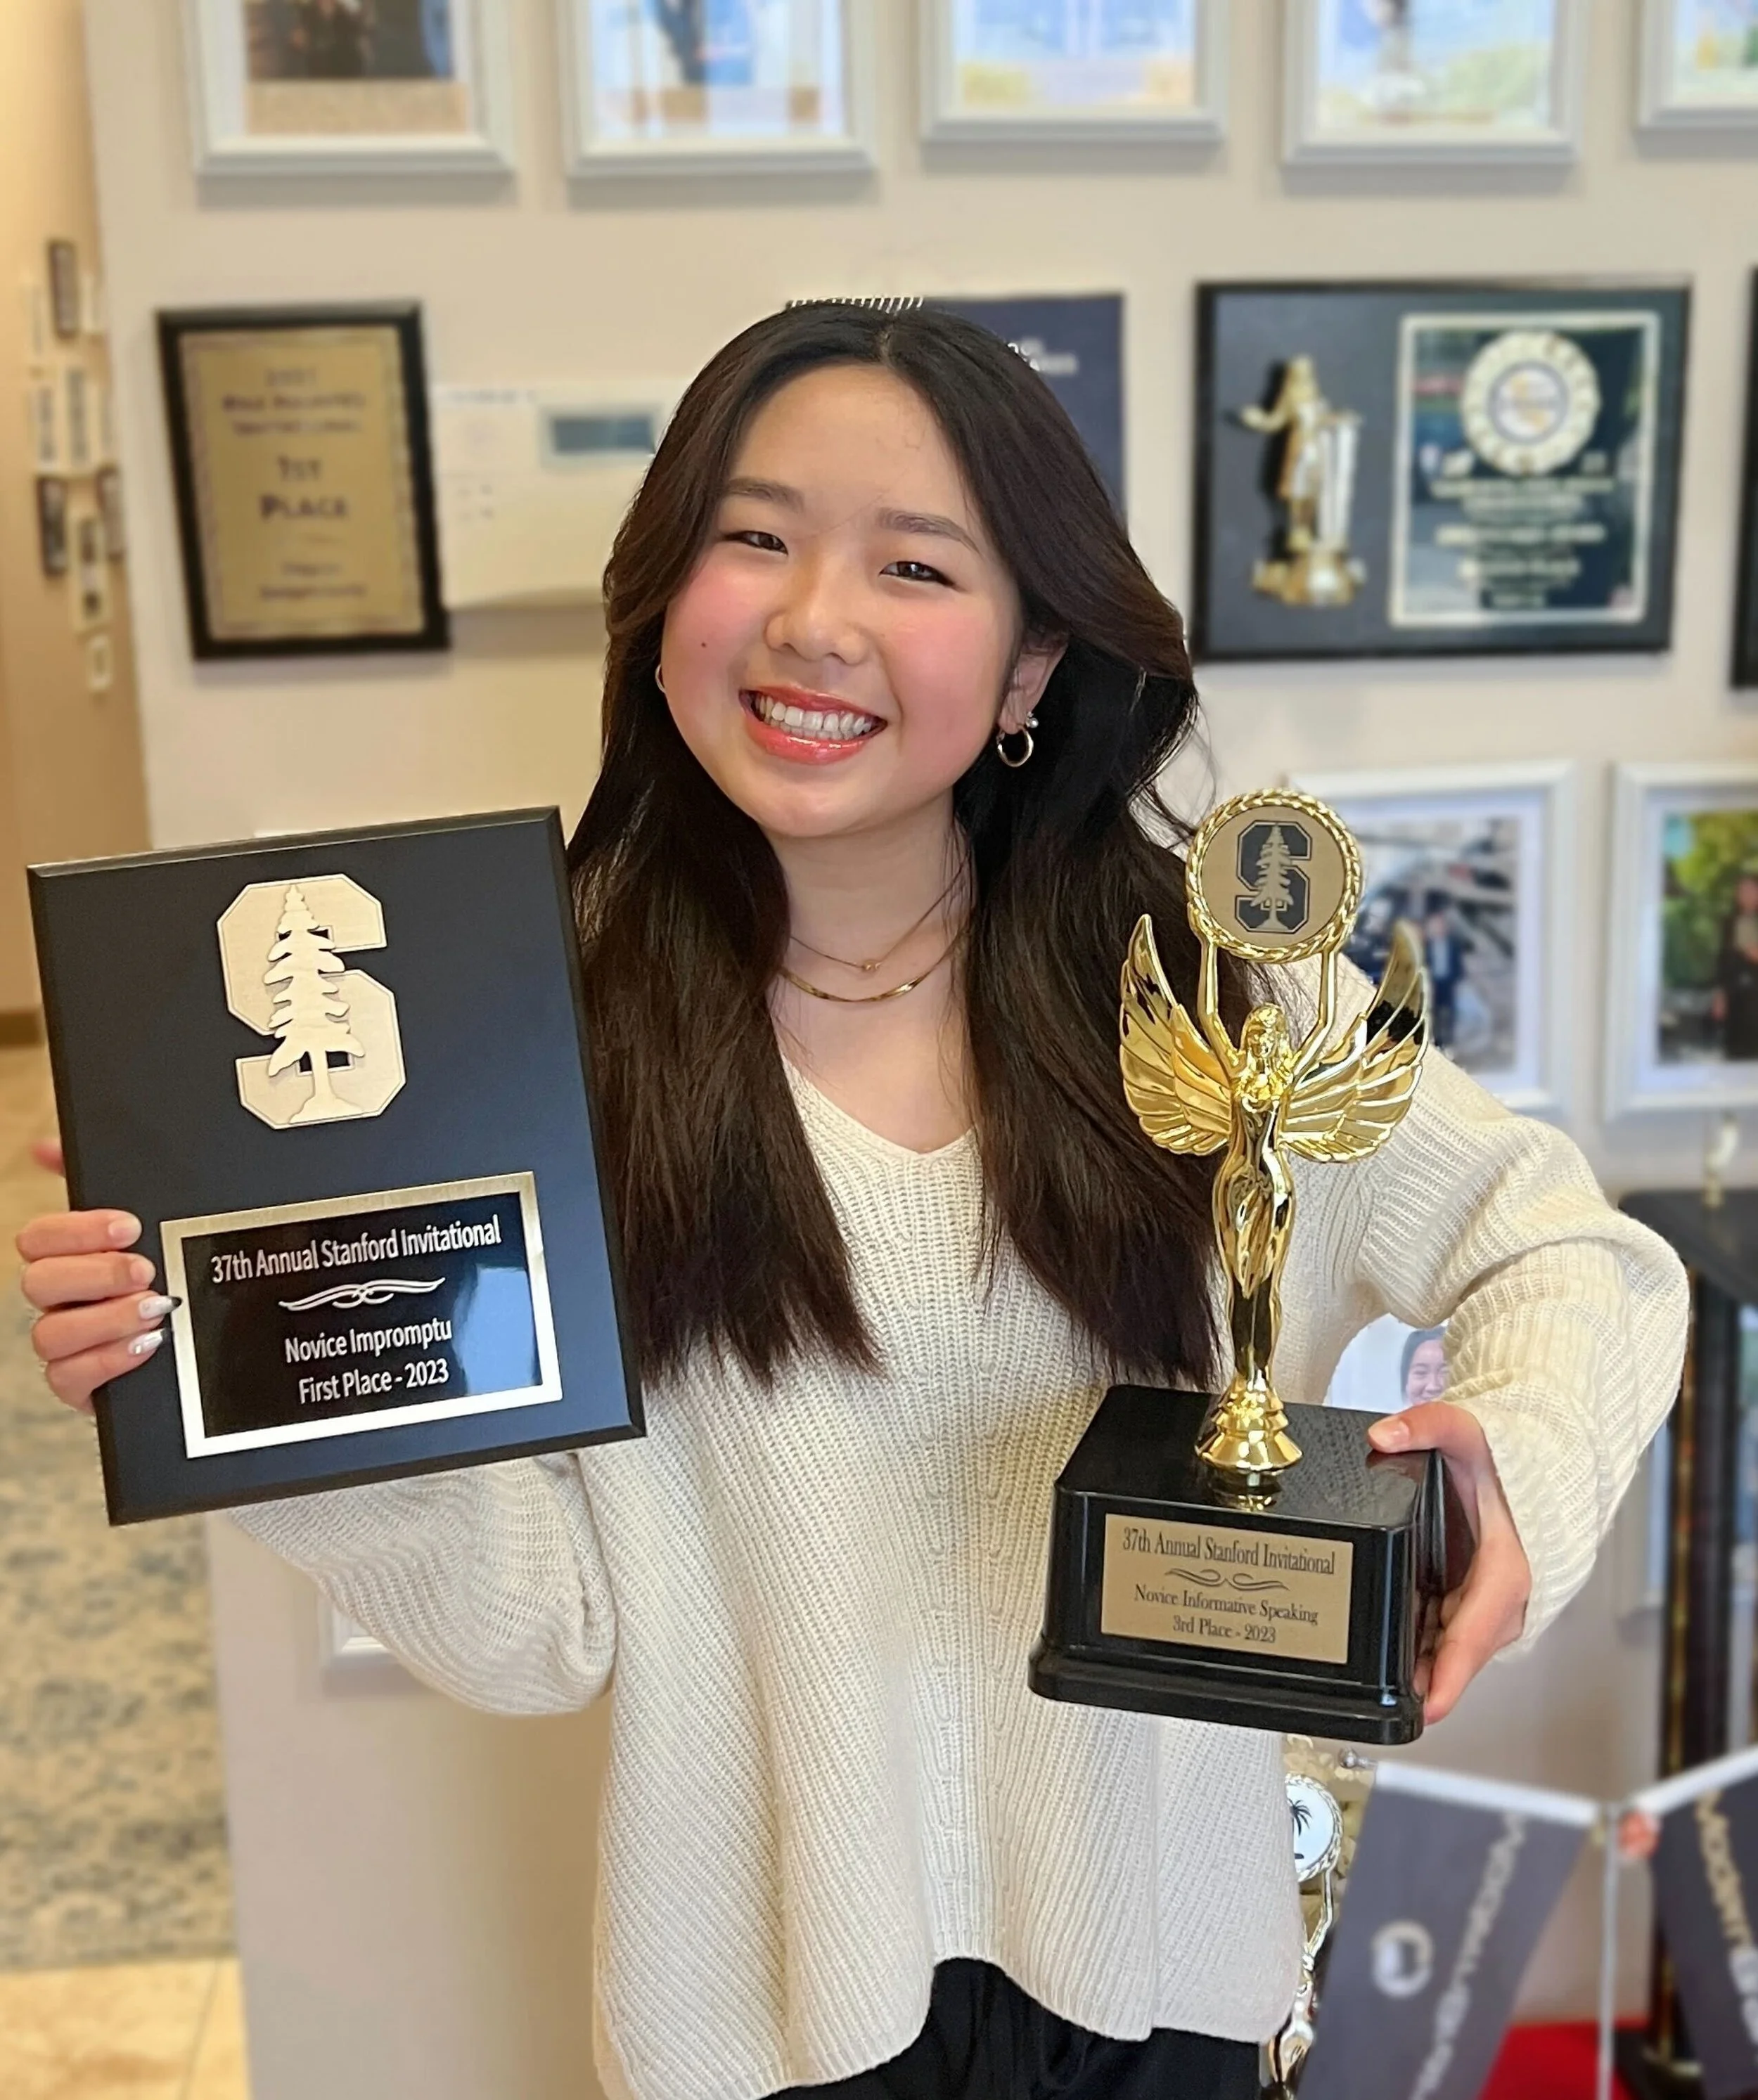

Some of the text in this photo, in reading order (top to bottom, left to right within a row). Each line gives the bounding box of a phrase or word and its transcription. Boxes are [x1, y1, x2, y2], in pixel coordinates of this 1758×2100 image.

[211, 1214, 502, 1284] 37th Annual Stanford Invitational
[285, 1317, 453, 1364] Novice Impromptu
[299, 1374, 341, 1405] First
[343, 1367, 392, 1397] Place
[405, 1358, 450, 1389] 2023
[1123, 1528, 1335, 1575] 37th Annual Stanford Invitational
[1134, 1583, 1318, 1625] Novice Informative Speaking
[1173, 1615, 1195, 1635] 3rd
[1199, 1618, 1232, 1638] Place
[1244, 1624, 1276, 1644] 2023
